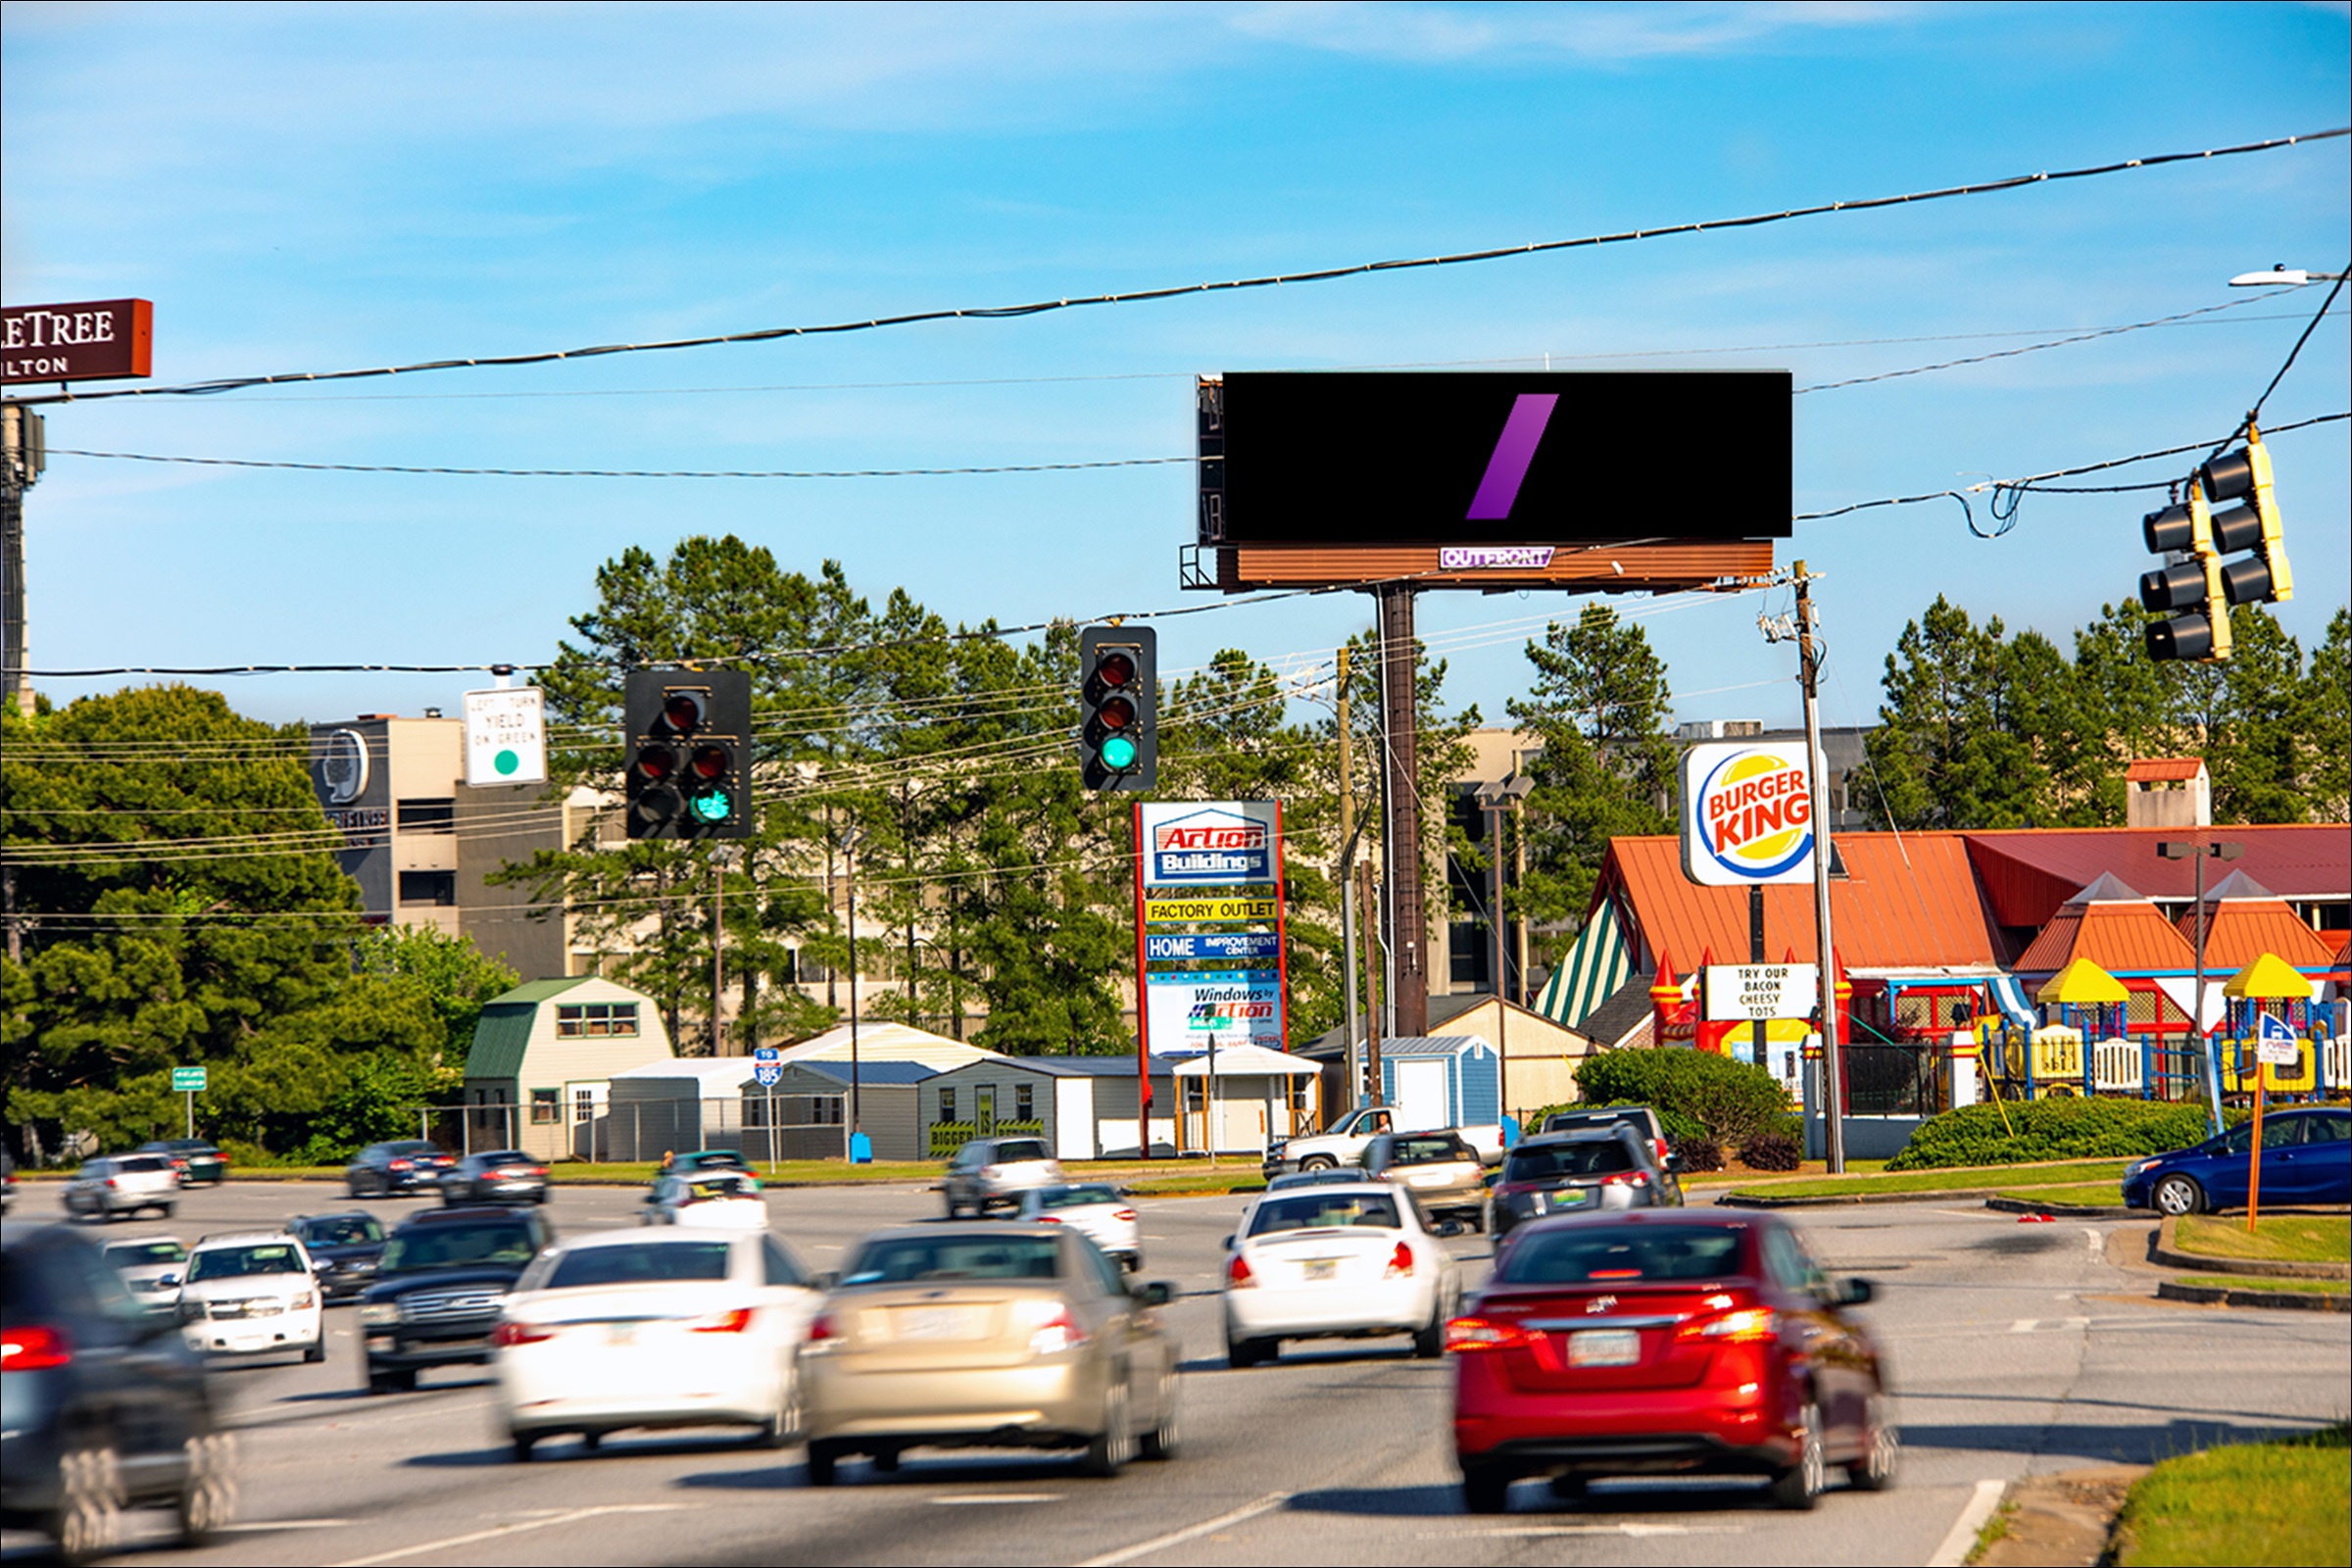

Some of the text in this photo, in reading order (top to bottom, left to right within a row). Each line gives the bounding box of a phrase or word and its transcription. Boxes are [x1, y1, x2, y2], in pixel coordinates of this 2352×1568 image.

[1, 311, 115, 349] ETREE
[1445, 550, 1547, 565] OUTFRONT
[470, 696, 536, 711] LEFT TURN
[484, 712, 524, 728] YIELD
[474, 732, 536, 746] ON GREEN
[1709, 769, 1805, 821] BURGER
[1715, 792, 1810, 854] KING
[1162, 827, 1264, 850] Action
[1161, 853, 1262, 872] Buildings
[1151, 902, 1275, 918] FACTORY OUTLET
[1149, 937, 1196, 956] HOME
[1205, 936, 1278, 948] IMPROVEMENT
[1225, 947, 1260, 956] CENTER
[1738, 967, 1788, 979] TRY OUR
[1195, 986, 1274, 1002] Windows by
[1744, 981, 1782, 992] BACON
[1739, 994, 1781, 1005] CHEESY
[1202, 1003, 1273, 1018] ction
[1748, 1006, 1777, 1017] TOTS
[759, 1068, 781, 1084] 185
[931, 1131, 974, 1146] BIGGER
